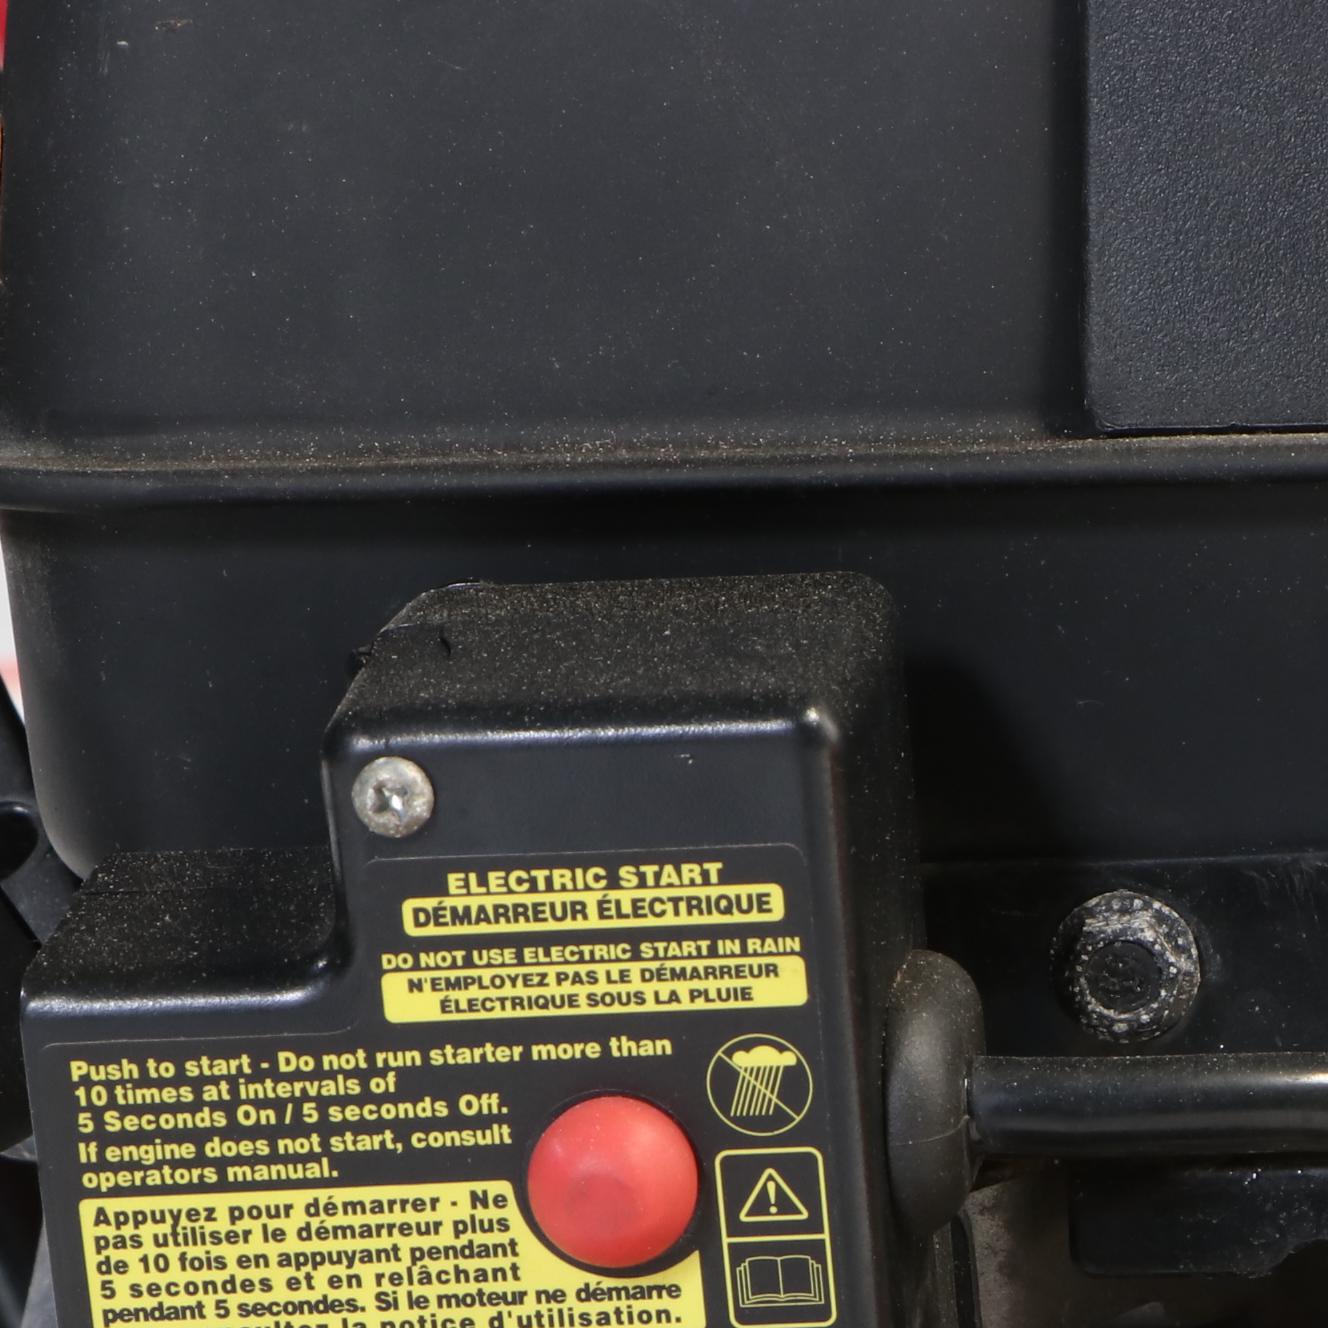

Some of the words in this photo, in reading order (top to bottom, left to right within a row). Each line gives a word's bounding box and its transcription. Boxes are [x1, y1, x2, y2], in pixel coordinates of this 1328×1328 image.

[446, 868, 607, 895] ELECTRIC
[618, 863, 722, 888] START
[411, 895, 588, 928] DÉMARREUR
[596, 888, 773, 922] ÉLECTRIQUE
[381, 954, 413, 969] DO
[419, 952, 466, 968] NOT
[472, 950, 517, 966] USE
[523, 945, 631, 964] ELECTRIC
[639, 942, 711, 959] START
[717, 941, 741, 956] IN
[746, 938, 800, 955] RAIN
[407, 973, 549, 994] N'EMPLOYEZ
[554, 971, 599, 988] PAS
[605, 970, 632, 986] LE
[639, 959, 779, 984] DÉMARREUR
[439, 989, 580, 1014] ÉLECTRIQUE
[585, 991, 646, 1008] SOUS
[653, 990, 682, 1006] LA
[688, 987, 754, 1004] PLUIE
[69, 1059, 139, 1081] Push
[145, 1059, 175, 1078] to
[184, 1056, 252, 1076] start
[277, 1052, 314, 1072] Do
[321, 1051, 367, 1071] not
[375, 1052, 421, 1068] run
[428, 1045, 523, 1066] starter
[530, 1045, 601, 1062] more
[608, 1038, 672, 1059] than
[74, 1086, 107, 1106] 10
[113, 1083, 194, 1104] times
[202, 1083, 230, 1101] at
[238, 1076, 361, 1099] intervals
[369, 1075, 396, 1094] of
[77, 1113, 94, 1133] 5
[103, 1107, 227, 1131] Seconds
[236, 1105, 276, 1126] On
[302, 1103, 319, 1123] 5
[327, 1098, 448, 1122] seconds
[458, 1095, 508, 1117] Off.
[78, 1143, 98, 1163] If
[104, 1139, 196, 1167] engine
[204, 1135, 270, 1157] does
[277, 1135, 322, 1154] not
[329, 1131, 402, 1156] start,
[410, 1125, 512, 1149] consult
[81, 1166, 218, 1193] operators
[226, 1160, 338, 1182] manual.
[93, 1202, 217, 1232] Appuyez
[228, 1204, 294, 1226] pour
[304, 1192, 440, 1218] démarrer
[469, 1190, 509, 1211] Ne
[93, 1235, 143, 1256] pas
[152, 1225, 252, 1248] utiliser
[261, 1224, 286, 1244] le
[296, 1217, 443, 1242] démarreur
[452, 1215, 510, 1241] plus
[95, 1254, 129, 1274] de
[138, 1253, 170, 1273] 10
[177, 1250, 228, 1271] fois
[235, 1253, 270, 1269] en
[276, 1245, 402, 1272] appuyant
[409, 1239, 519, 1267] pendant
[100, 1280, 116, 1299] 5
[128, 1273, 273, 1297] secondes
[285, 1272, 315, 1291] et
[327, 1274, 362, 1289] en
[374, 1261, 521, 1287] relâchant
[101, 1300, 206, 1328] pendant
[214, 1299, 230, 1319] 5
[236, 1294, 366, 1318] secondes.
[374, 1293, 399, 1312] Si
[406, 1291, 430, 1311] le
[436, 1289, 528, 1309] moteur
[534, 1290, 566, 1305] ne
[574, 1280, 681, 1304] démarre
